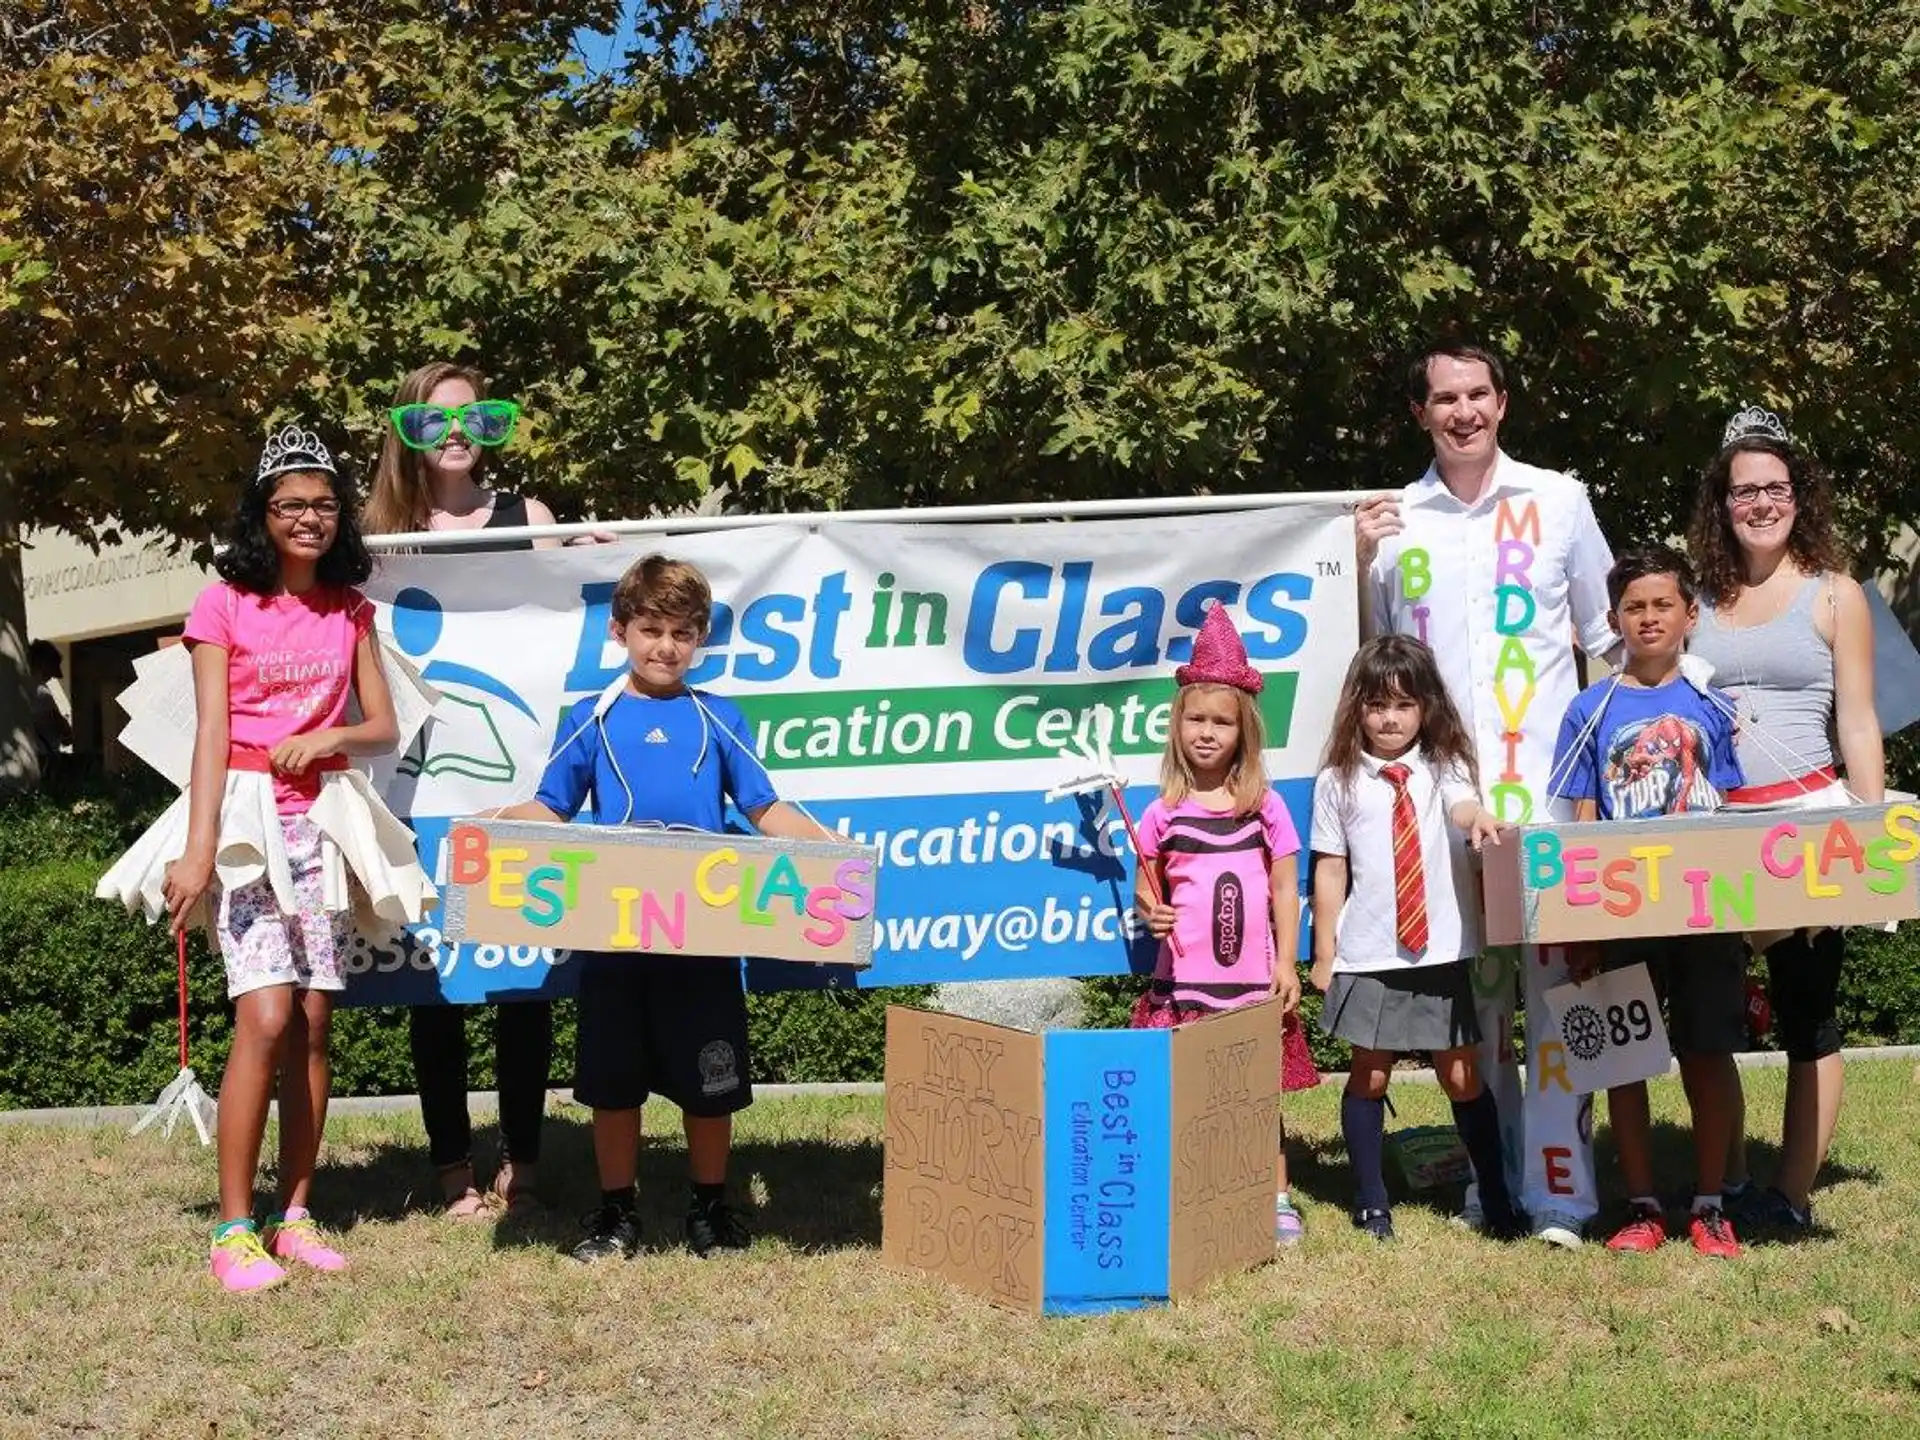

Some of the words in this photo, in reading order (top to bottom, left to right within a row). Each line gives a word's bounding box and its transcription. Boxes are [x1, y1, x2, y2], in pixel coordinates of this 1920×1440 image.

[865, 572, 949, 648] in
[962, 560, 1314, 675] Class
[993, 694, 1173, 750] Cente
[450, 824, 597, 927] BEST
[609, 886, 686, 950] IN
[695, 847, 876, 947] CLASS
[1522, 829, 1674, 917] BEST
[1683, 868, 1756, 930] IN
[1760, 803, 1920, 897] CLASS
[1218, 882, 1239, 955] Crayola
[921, 1026, 1005, 1101] MY
[1606, 998, 1653, 1047] 89
[885, 1081, 1041, 1207] STORY
[1101, 1069, 1138, 1145] Best
[1117, 1152, 1142, 1175] in
[906, 1185, 1036, 1301] BOOK
[1096, 1180, 1136, 1270] Class
